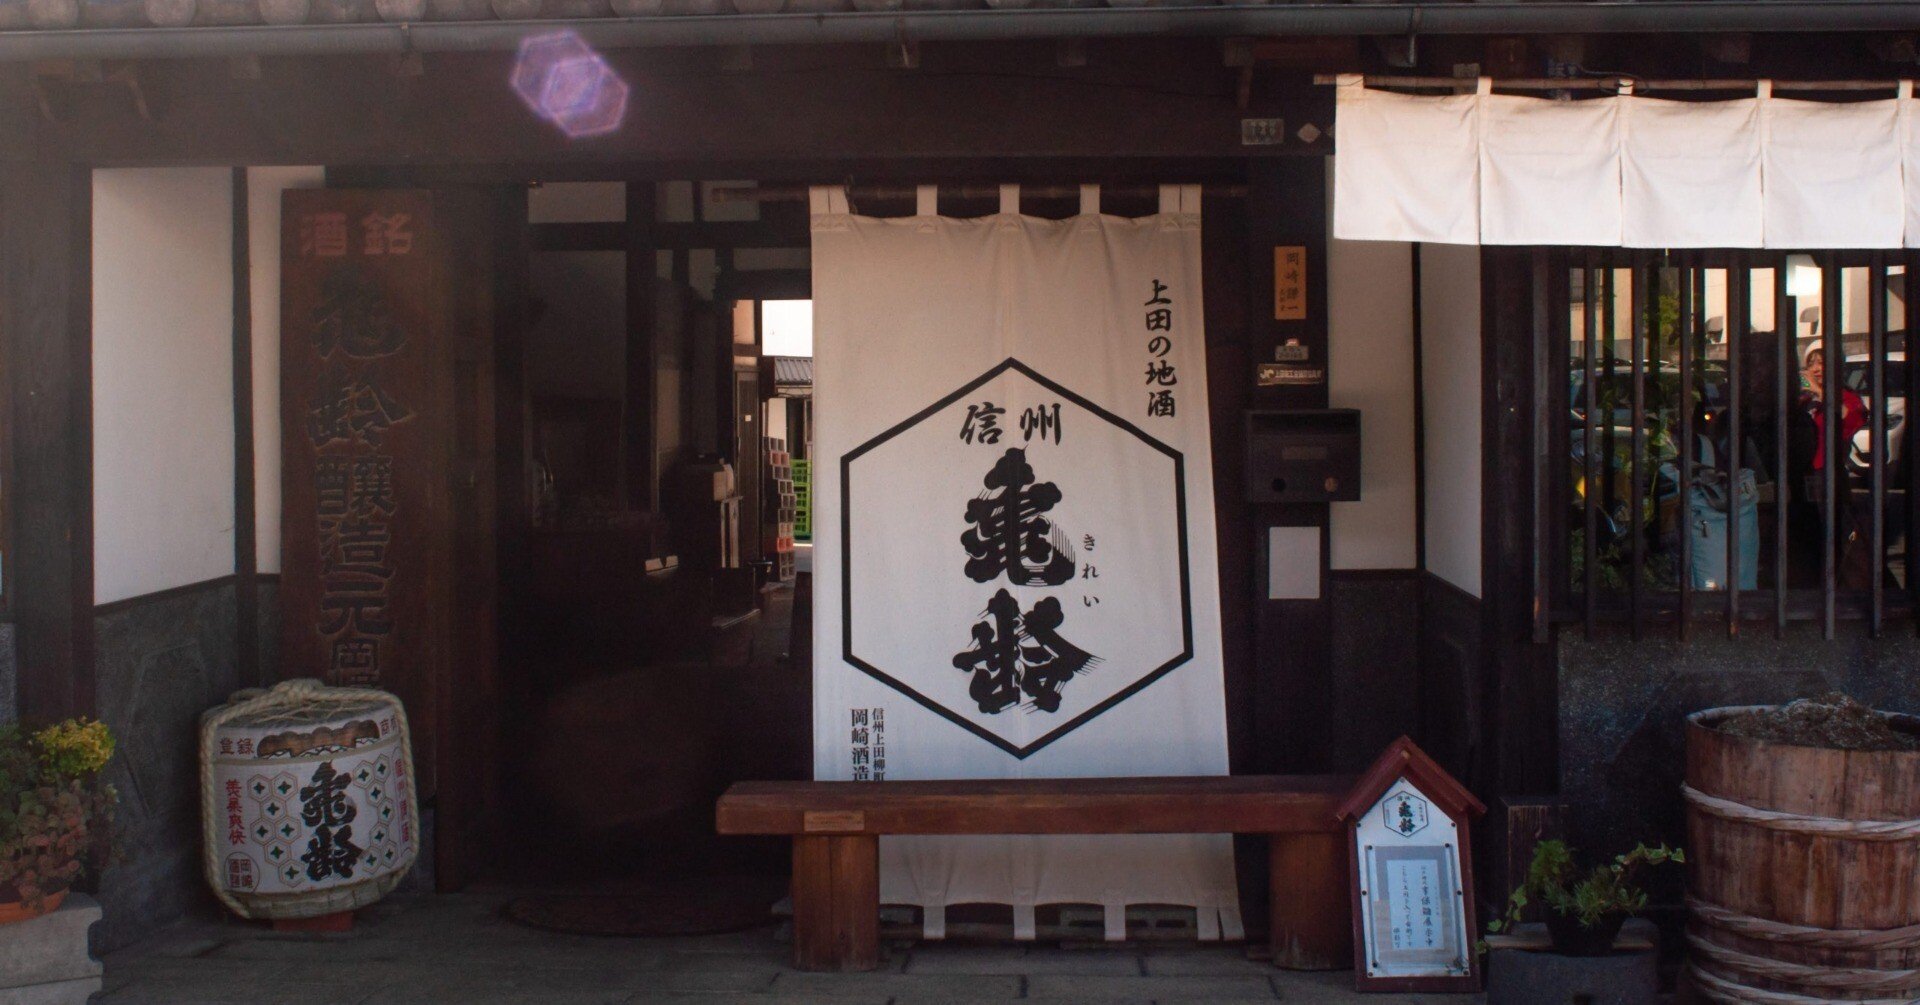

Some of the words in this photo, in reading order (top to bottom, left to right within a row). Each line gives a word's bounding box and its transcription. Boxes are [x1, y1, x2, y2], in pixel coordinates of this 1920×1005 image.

[1144, 279, 1177, 418] 上田の地酒
[960, 402, 1062, 446] 信州
[1082, 533, 1100, 607] きれい
[219, 737, 254, 755] 登録
[851, 708, 870, 781] 岡崎酒造
